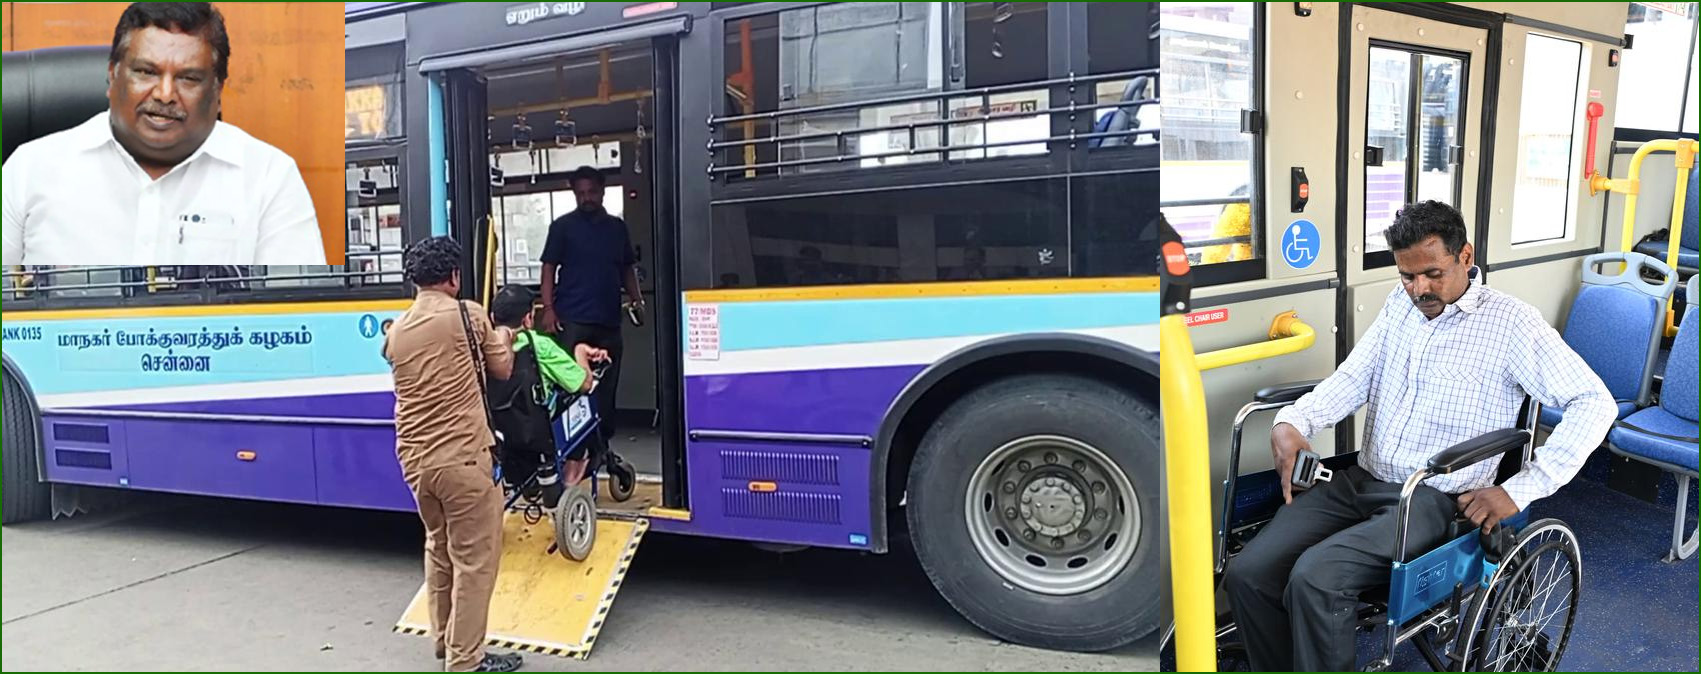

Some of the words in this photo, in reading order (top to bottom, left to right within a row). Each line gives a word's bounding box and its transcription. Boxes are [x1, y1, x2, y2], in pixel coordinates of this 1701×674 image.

[1195, 314, 1210, 322] CHAIR
[1211, 312, 1225, 320] USER
[21, 326, 42, 340] 0135
[57, 328, 112, 350] மாநகர்
[116, 326, 243, 350] போக்குவரத்துக்
[249, 324, 312, 350] கழகம்
[141, 348, 211, 371] சென்னை
